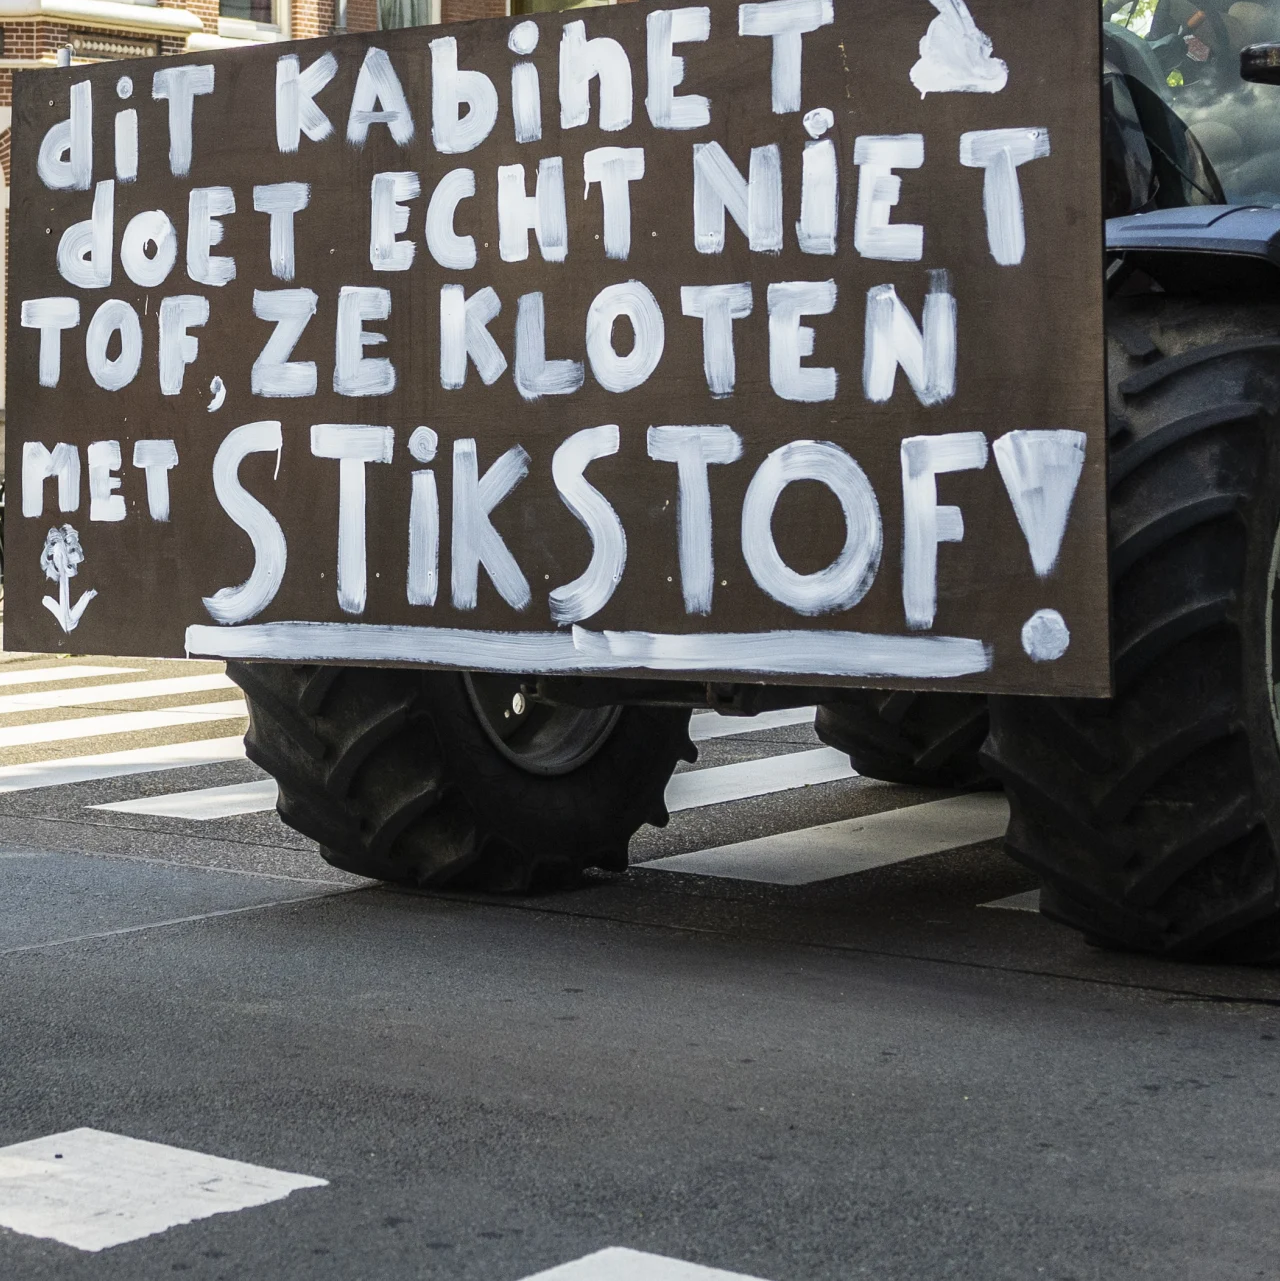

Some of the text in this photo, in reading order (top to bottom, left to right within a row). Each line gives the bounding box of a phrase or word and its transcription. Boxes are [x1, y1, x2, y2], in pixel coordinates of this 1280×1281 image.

[370, 146, 646, 272] ECHT
[21, 270, 958, 413] TOF, ZE KLOTEN
[22, 439, 179, 523] MET
